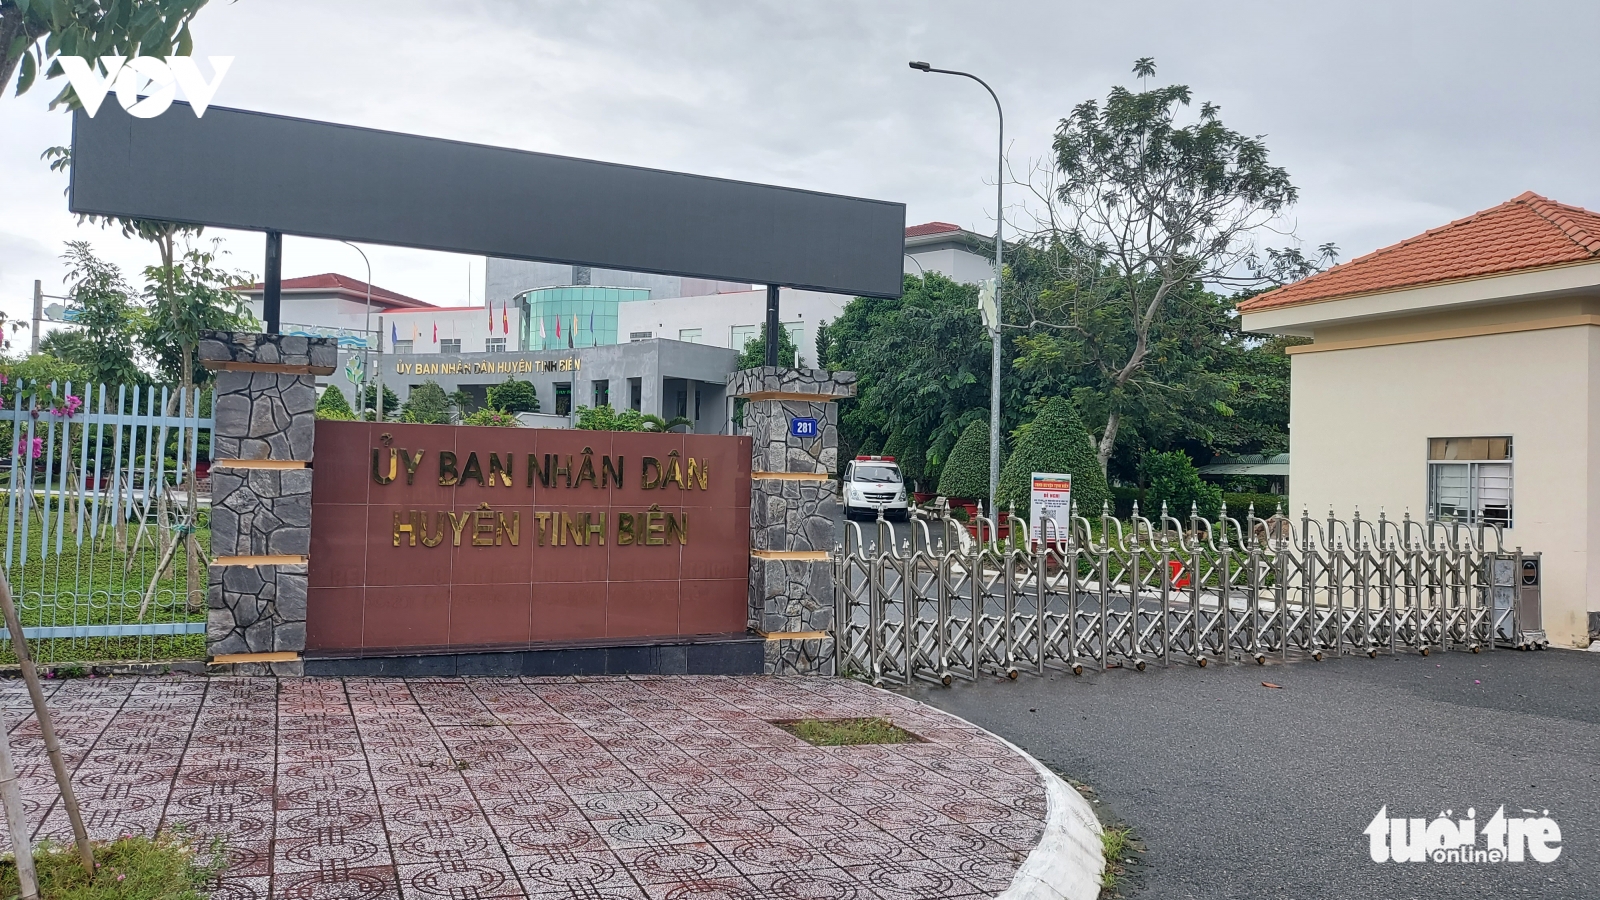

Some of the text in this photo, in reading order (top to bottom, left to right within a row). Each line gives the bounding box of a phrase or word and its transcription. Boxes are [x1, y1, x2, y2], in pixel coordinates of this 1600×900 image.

[396, 359, 413, 375] ỦY
[415, 363, 439, 375] BAN
[441, 360, 471, 375] NHÂN
[474, 359, 495, 375] DÂN
[497, 358, 532, 376] HUYỆN
[535, 360, 557, 376] TỊNH
[797, 422, 812, 434] 281
[372, 432, 709, 490] ỦY BAN NHÂN DÂN
[617, 502, 689, 547] BIÊN
